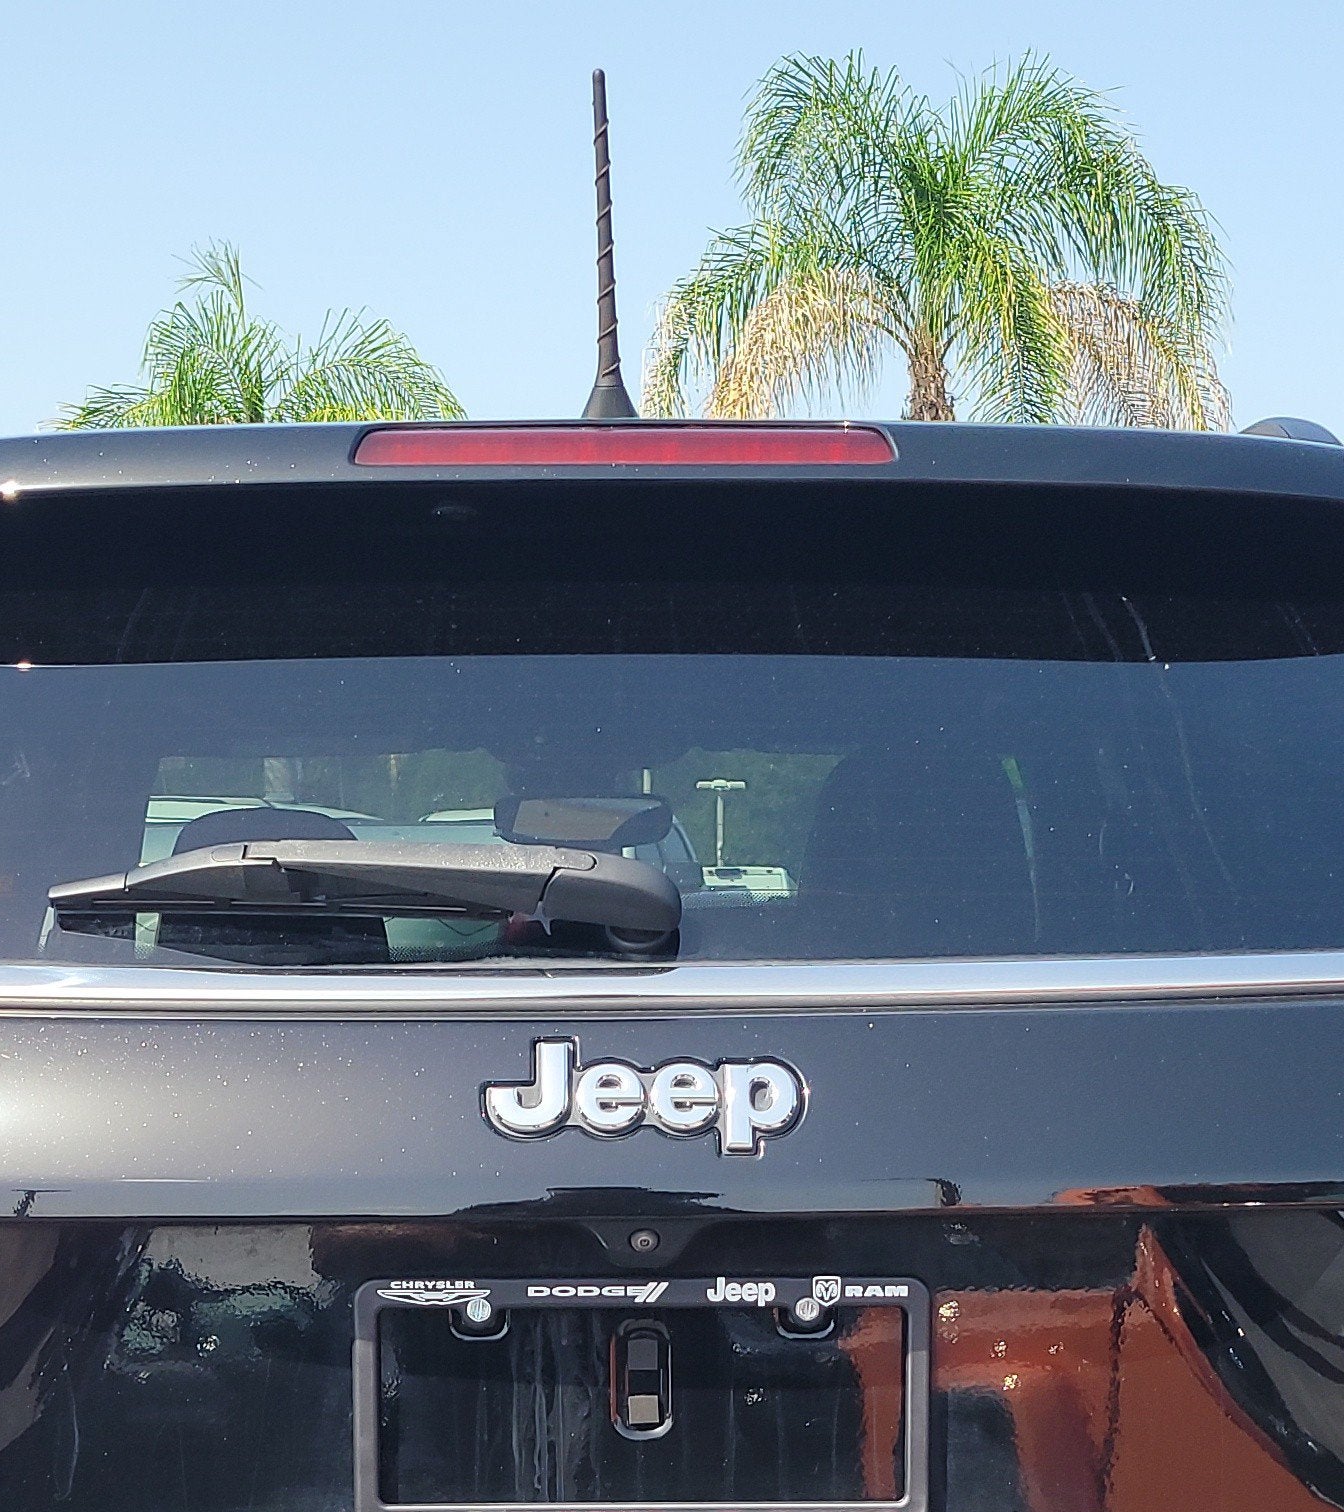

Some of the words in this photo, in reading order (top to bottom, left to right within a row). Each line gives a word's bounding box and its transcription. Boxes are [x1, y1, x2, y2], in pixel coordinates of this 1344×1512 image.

[480, 1035, 807, 1156] Jeep
[390, 1280, 476, 1289] CHRYSLER
[527, 1285, 646, 1298] DODGE
[706, 1277, 776, 1307] Jeep
[845, 1285, 909, 1297] RAM
